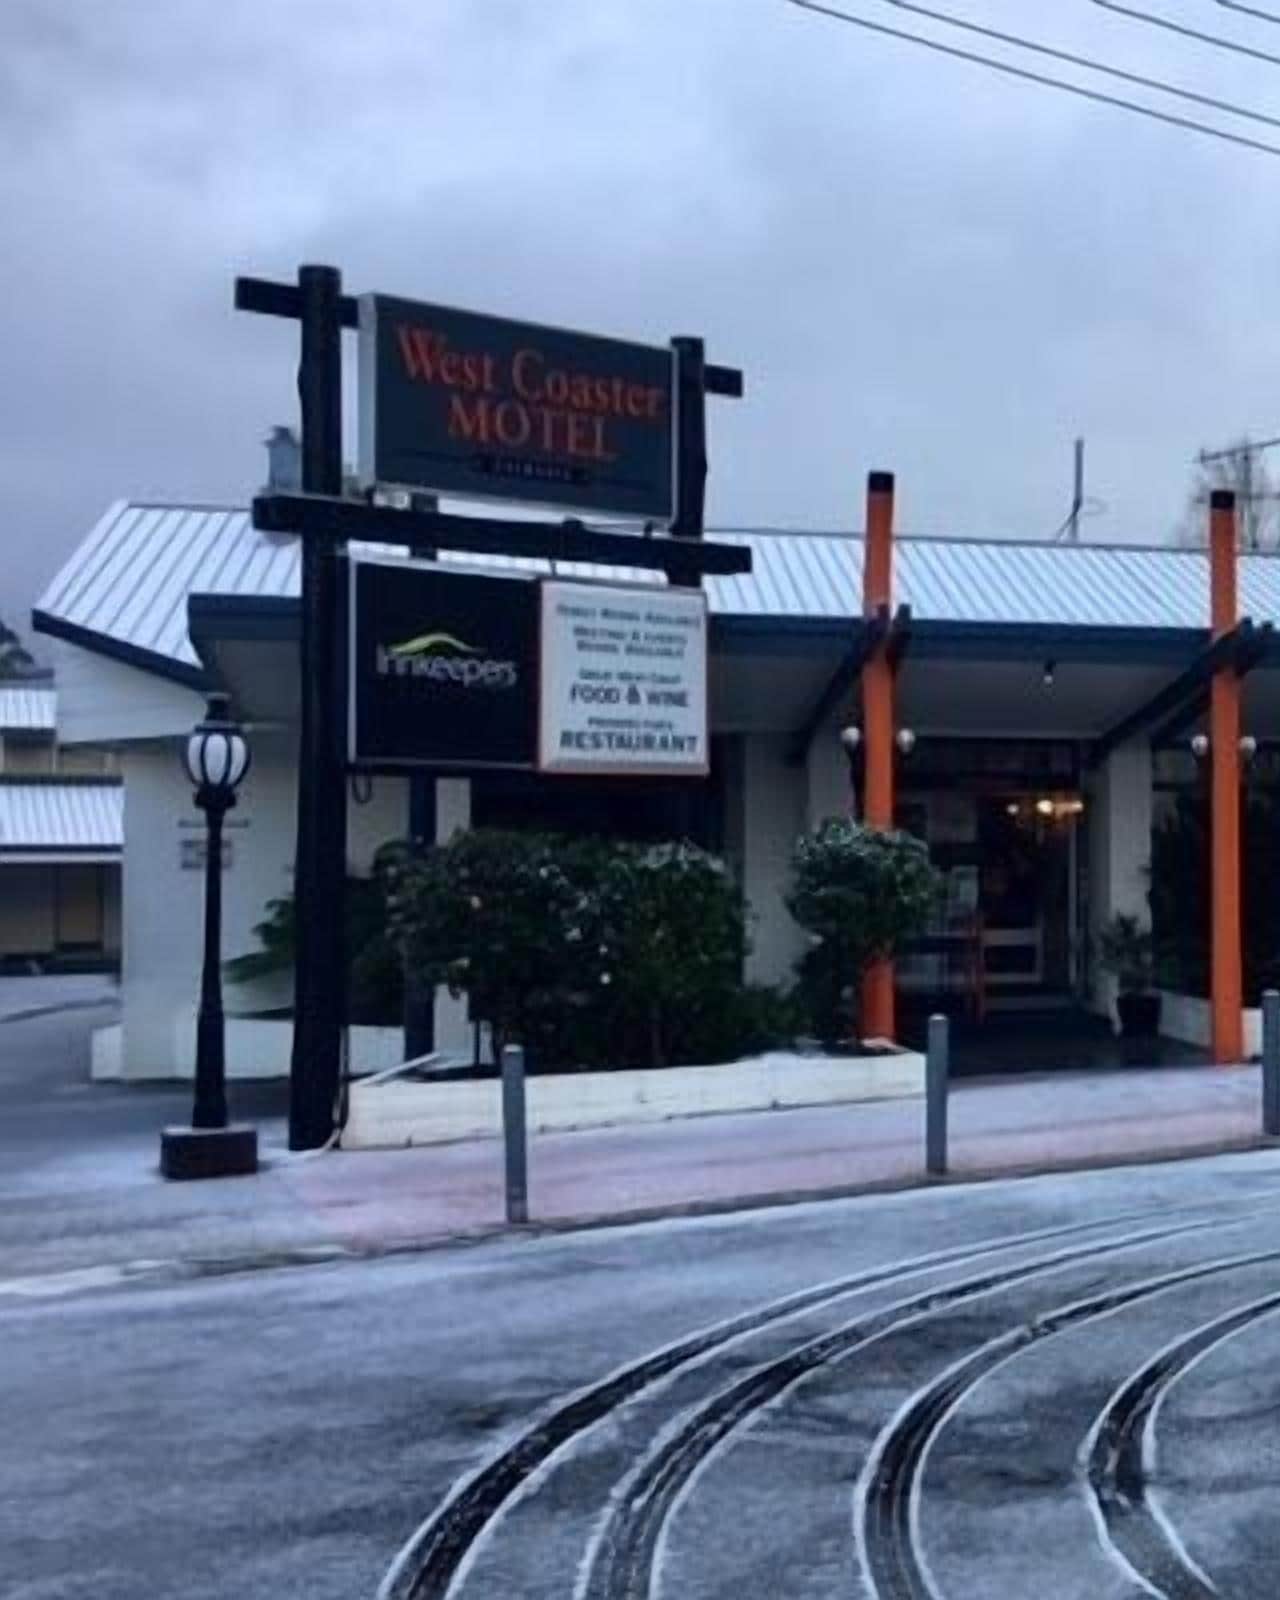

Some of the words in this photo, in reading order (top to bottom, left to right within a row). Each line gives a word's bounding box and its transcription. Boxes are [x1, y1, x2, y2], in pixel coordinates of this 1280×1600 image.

[394, 321, 497, 392] West
[510, 348, 664, 417] Coaster
[447, 392, 619, 460] MOTEL
[375, 642, 517, 688] Innkeepers
[570, 683, 620, 705] FOOD
[645, 688, 689, 708] WINE
[559, 730, 698, 751] RESTAURANT
